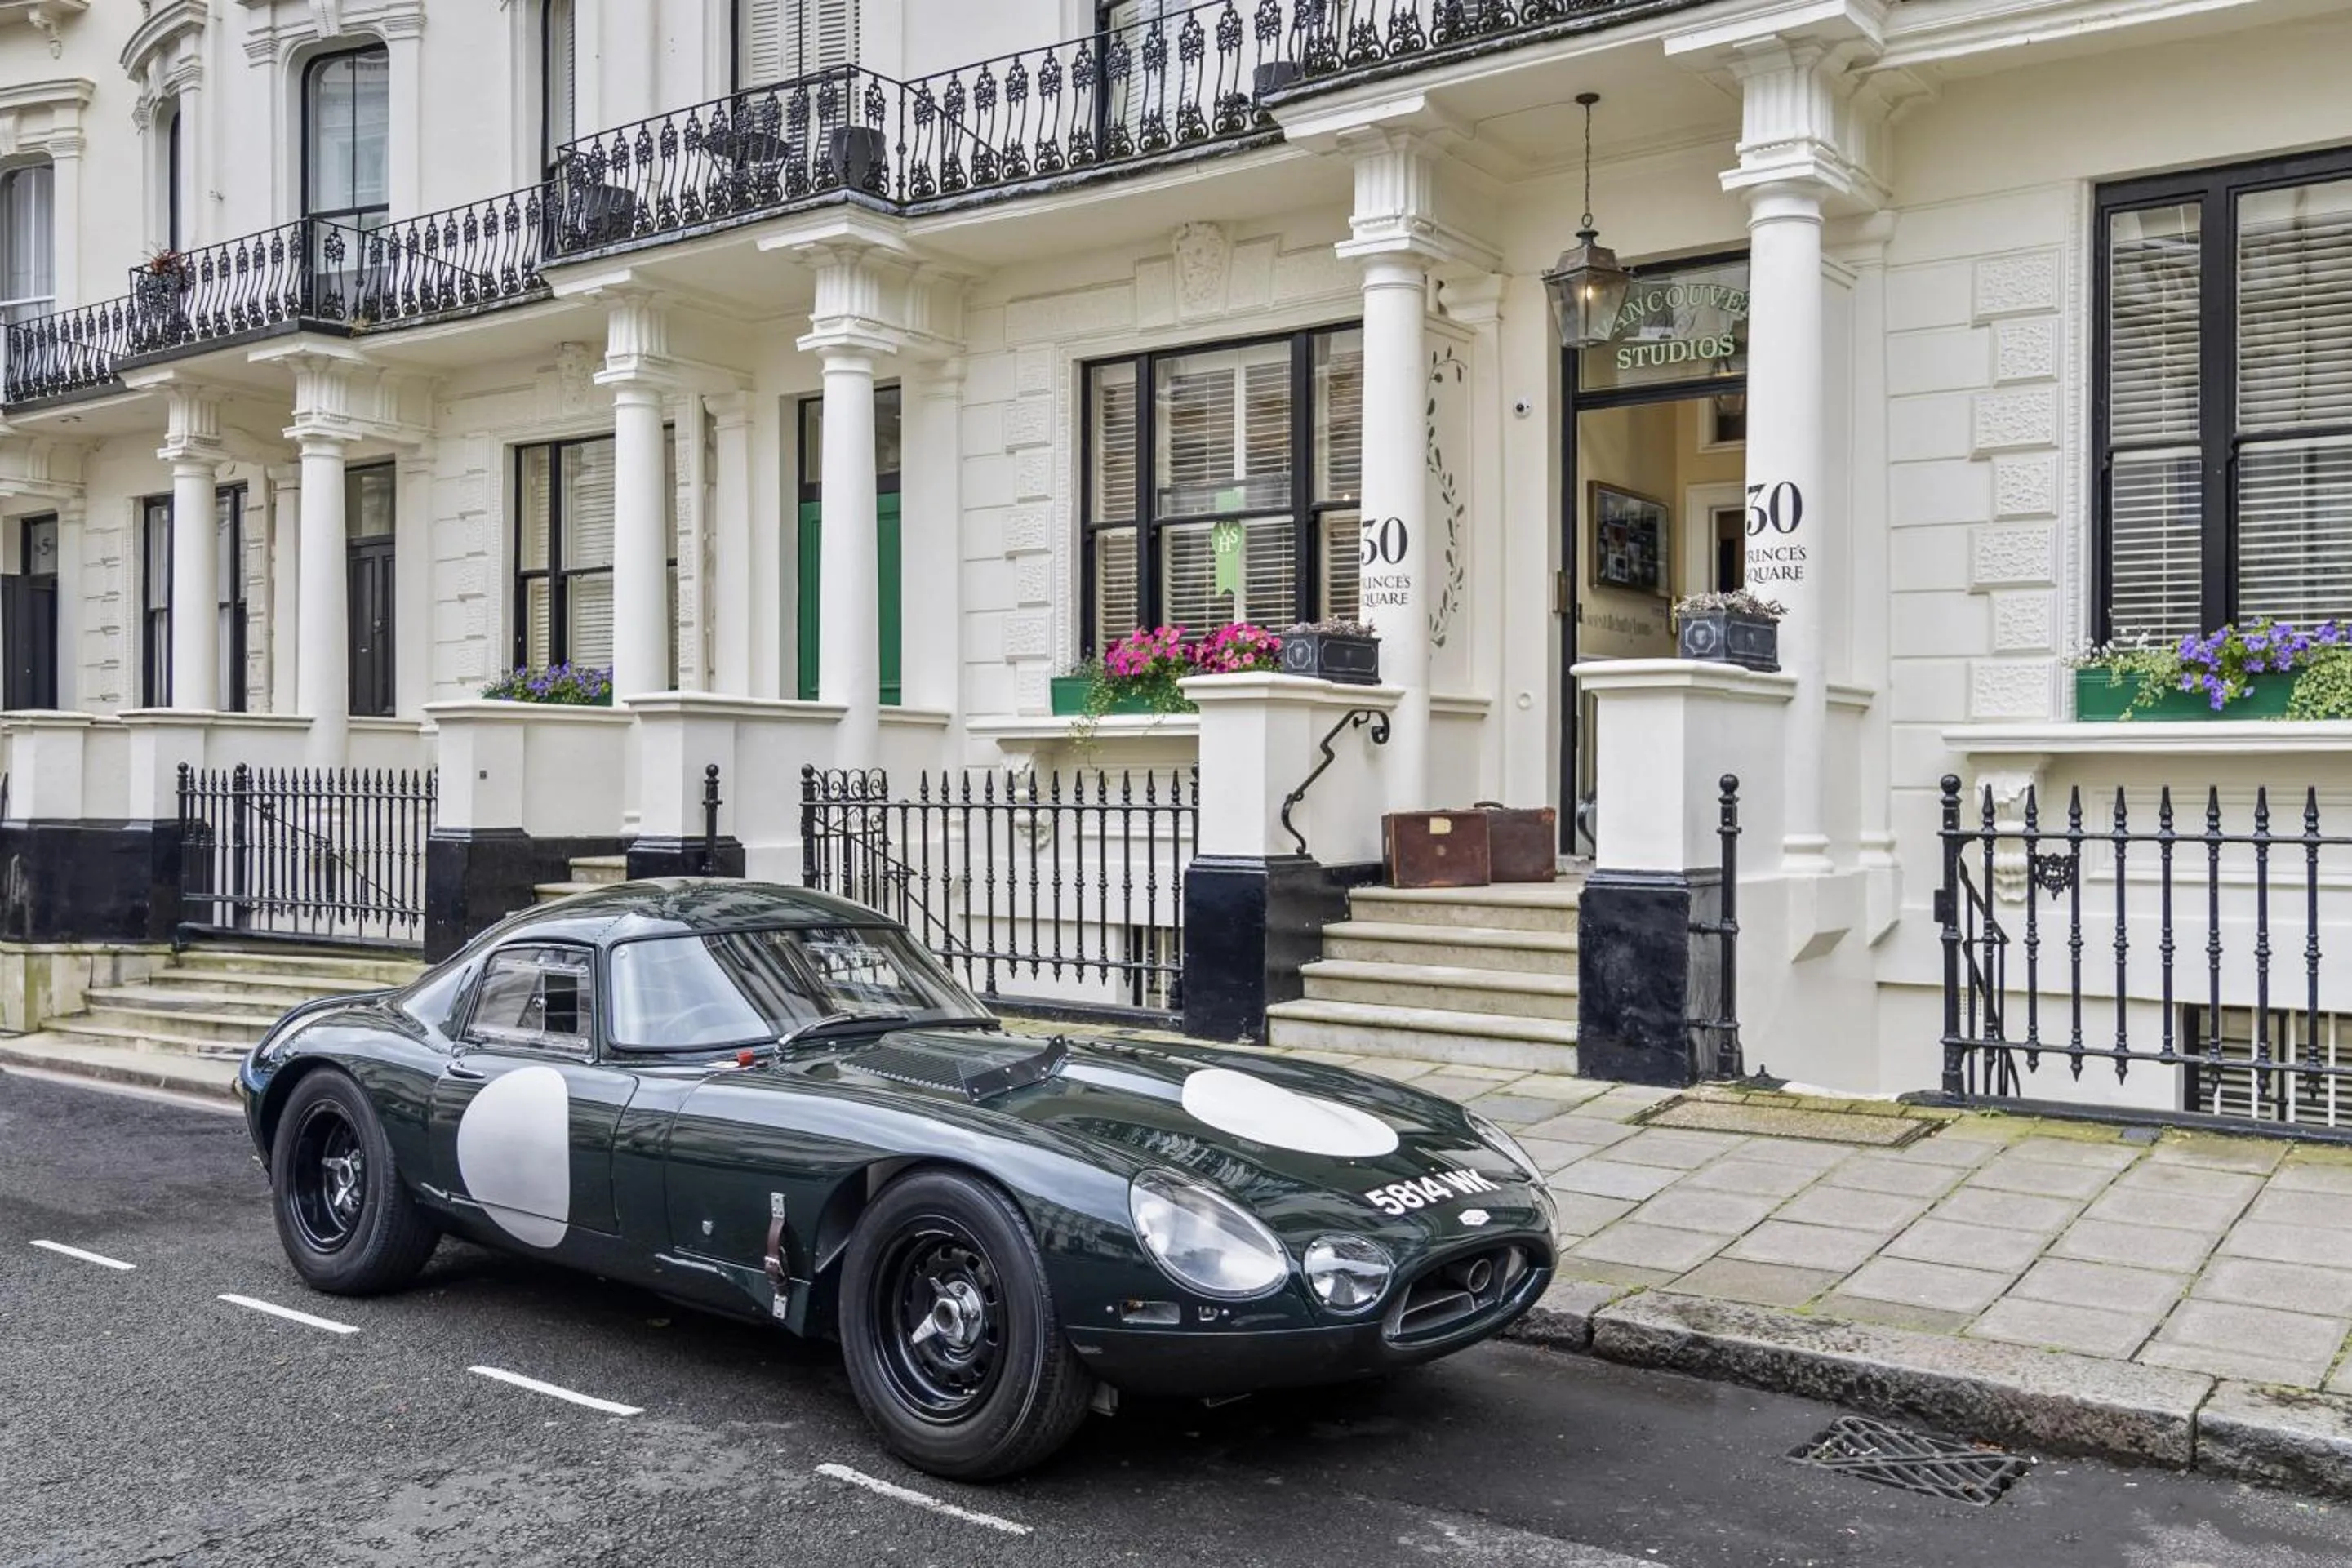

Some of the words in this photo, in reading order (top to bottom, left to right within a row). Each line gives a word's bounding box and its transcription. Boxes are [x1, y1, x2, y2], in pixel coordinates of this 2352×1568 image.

[1617, 334, 1735, 370] STUDIOS
[1746, 481, 1803, 537] 30
[1360, 517, 1408, 566] 30
[1747, 544, 1807, 563] RINCE'S
[1746, 565, 1804, 584] QUARE
[1364, 592, 1409, 607] QUARE
[1365, 1175, 1454, 1215] 5814
[1435, 1168, 1502, 1194] WK
